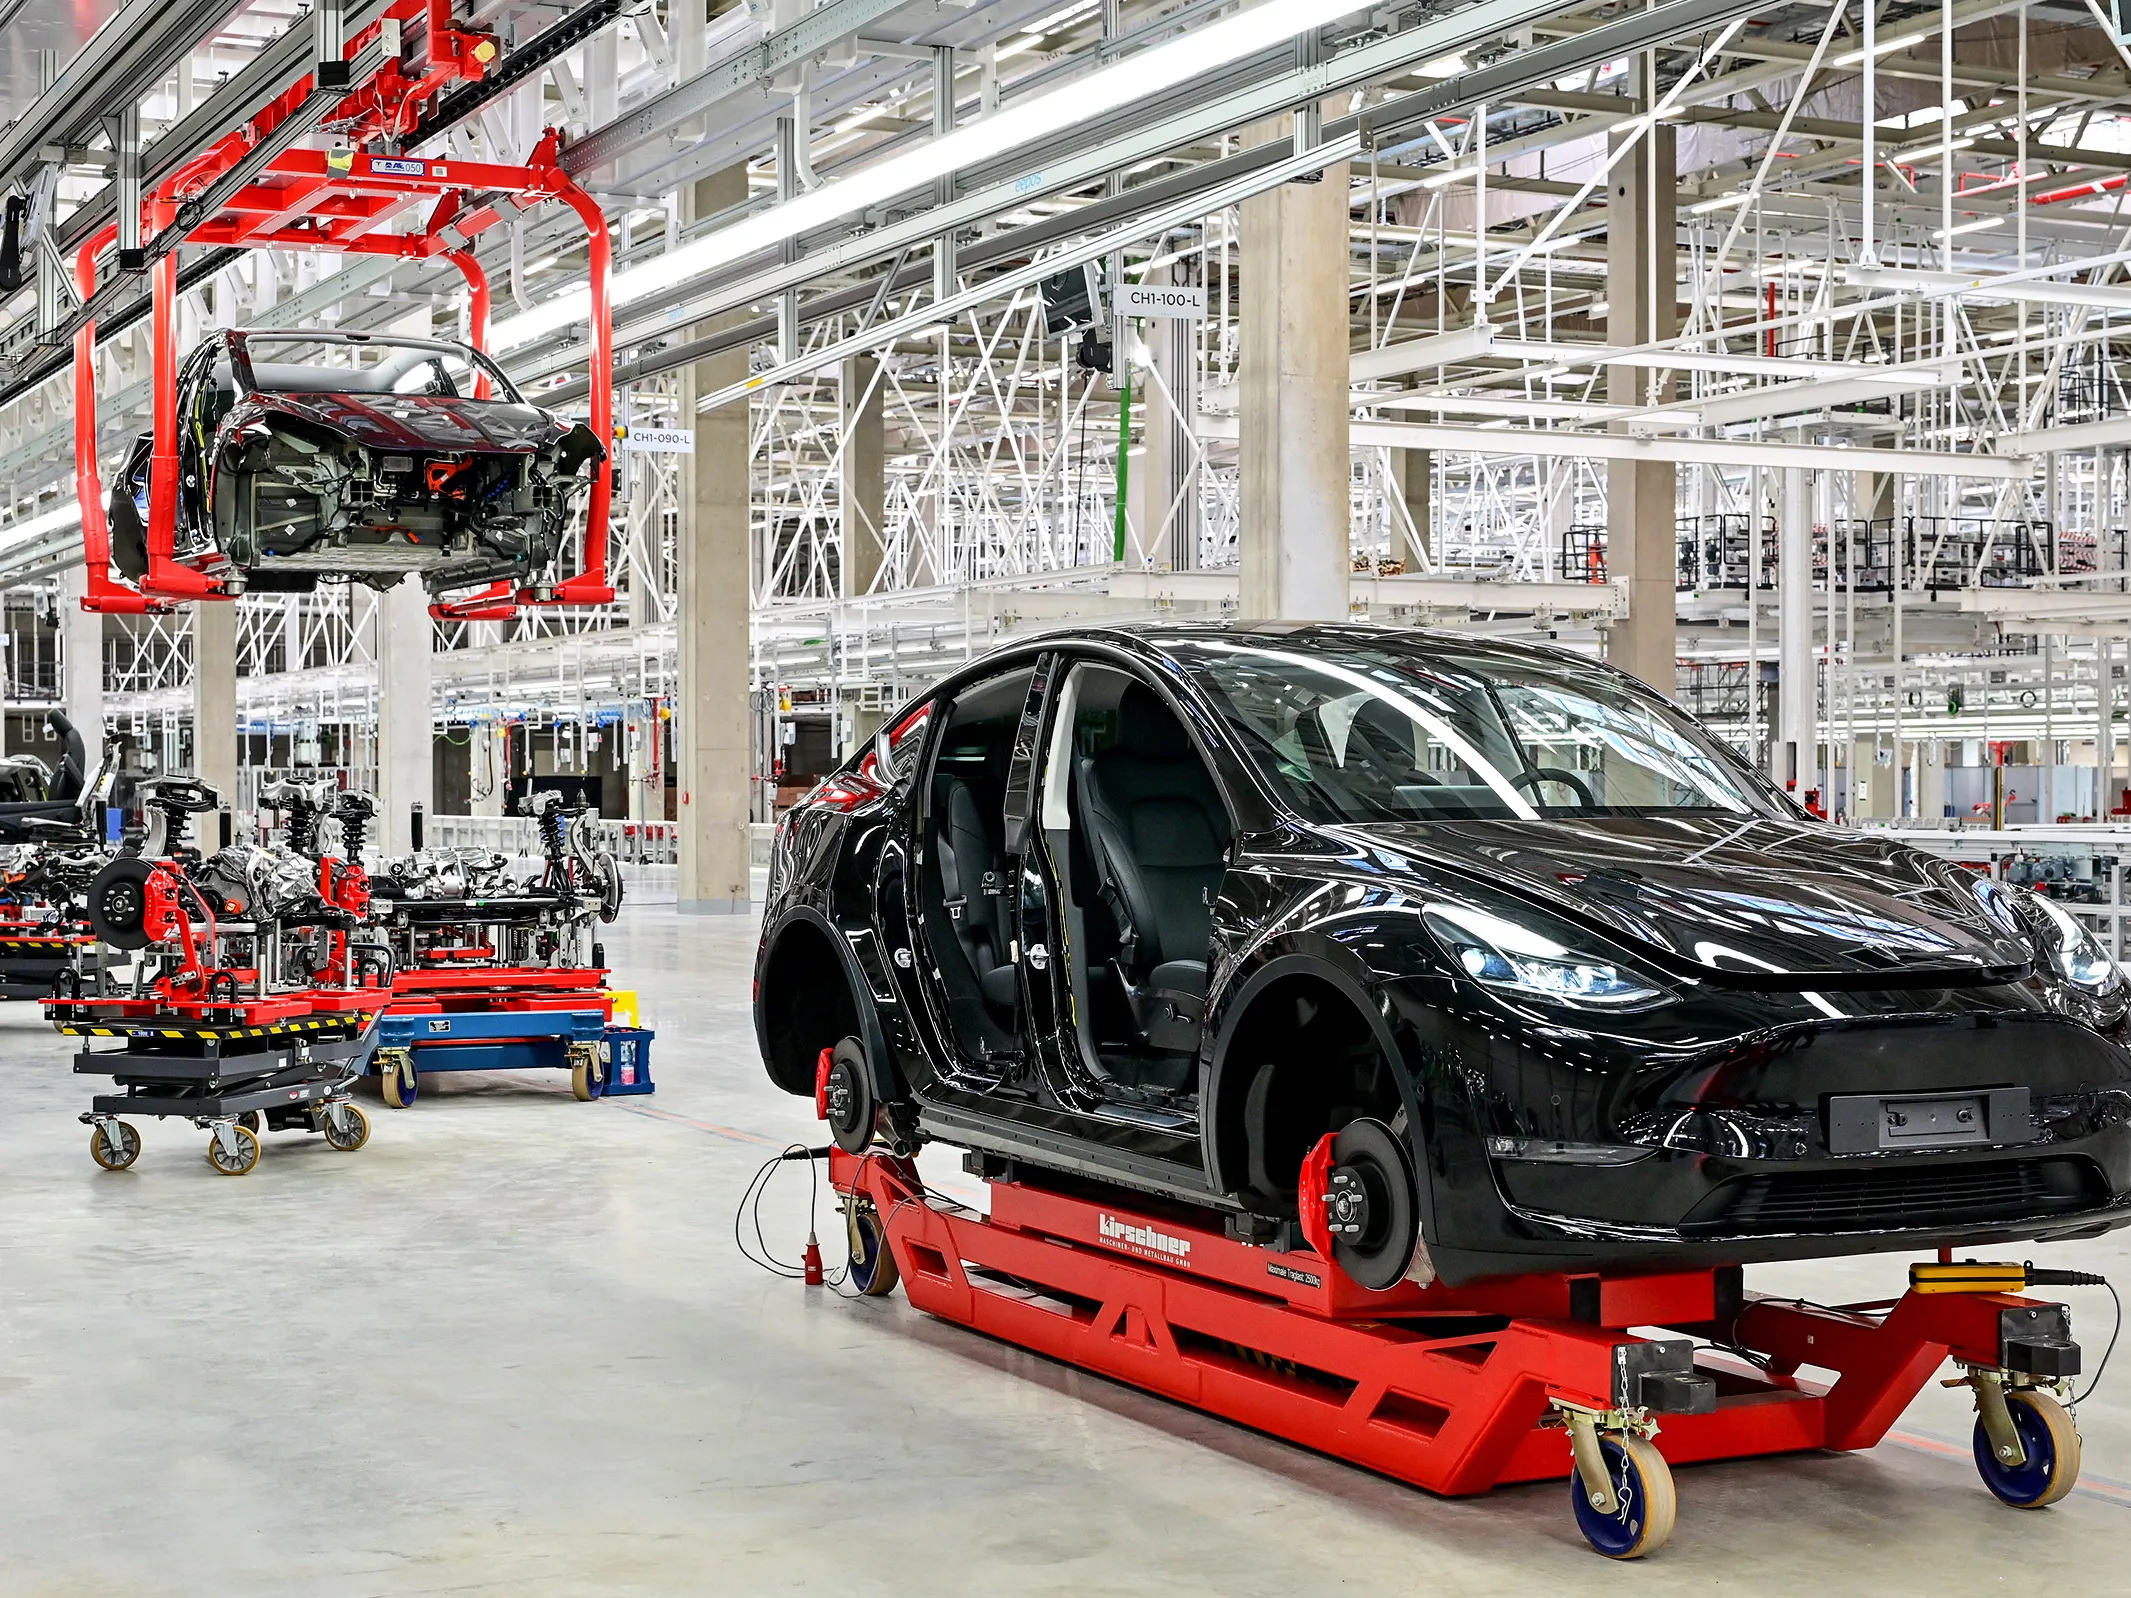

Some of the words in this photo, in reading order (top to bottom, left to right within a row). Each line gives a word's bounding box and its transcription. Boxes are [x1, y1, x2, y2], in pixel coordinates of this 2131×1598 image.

[405, 163, 421, 173] 050
[1130, 291, 1200, 307] CH1-100-L
[633, 432, 690, 444] CH1-090-L
[1099, 1213, 1191, 1257] kirschner
[1131, 1246, 1142, 1255] UND
[1143, 1249, 1174, 1264] METALLBAU
